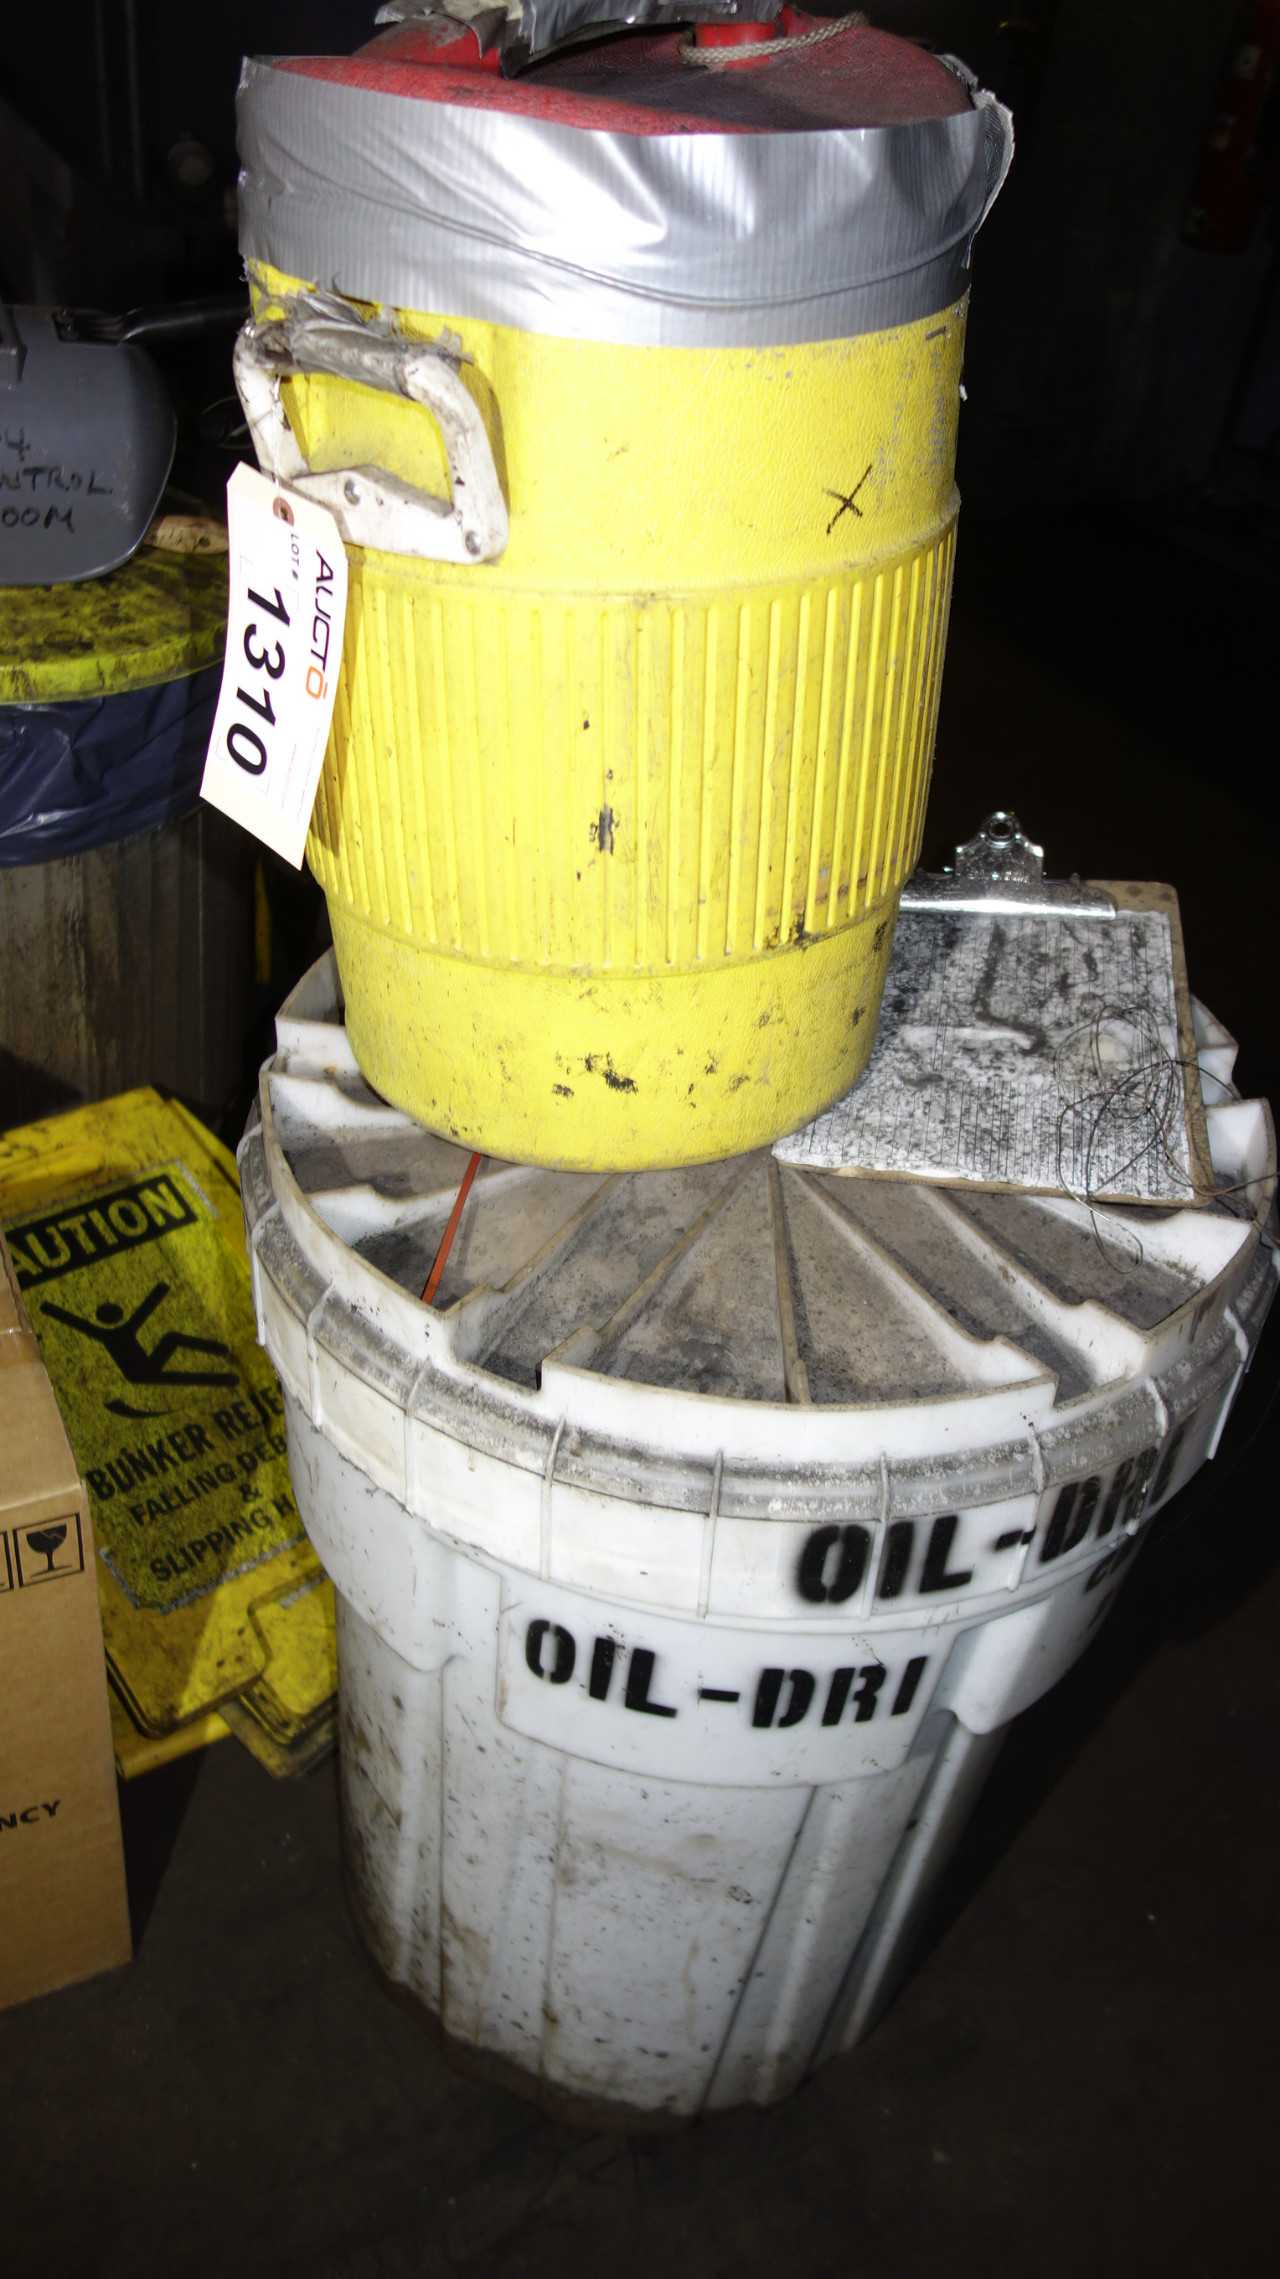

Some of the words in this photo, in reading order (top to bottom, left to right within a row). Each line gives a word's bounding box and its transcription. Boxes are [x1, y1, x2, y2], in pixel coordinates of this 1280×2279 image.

[1, 504, 76, 535] OOM
[225, 586, 291, 777] 1310
[12, 1182, 187, 1276] AUTION
[85, 1423, 215, 1501] BUNKER
[213, 1381, 284, 1440] REJE
[130, 1461, 237, 1527] FALLING
[239, 1482, 262, 1504] &
[796, 1430, 1185, 1604] OIL-DRI
[150, 1508, 273, 1582] SLIPPING
[525, 1618, 929, 1729] OIL-DRI
[0, 1799, 61, 1832] NCY
